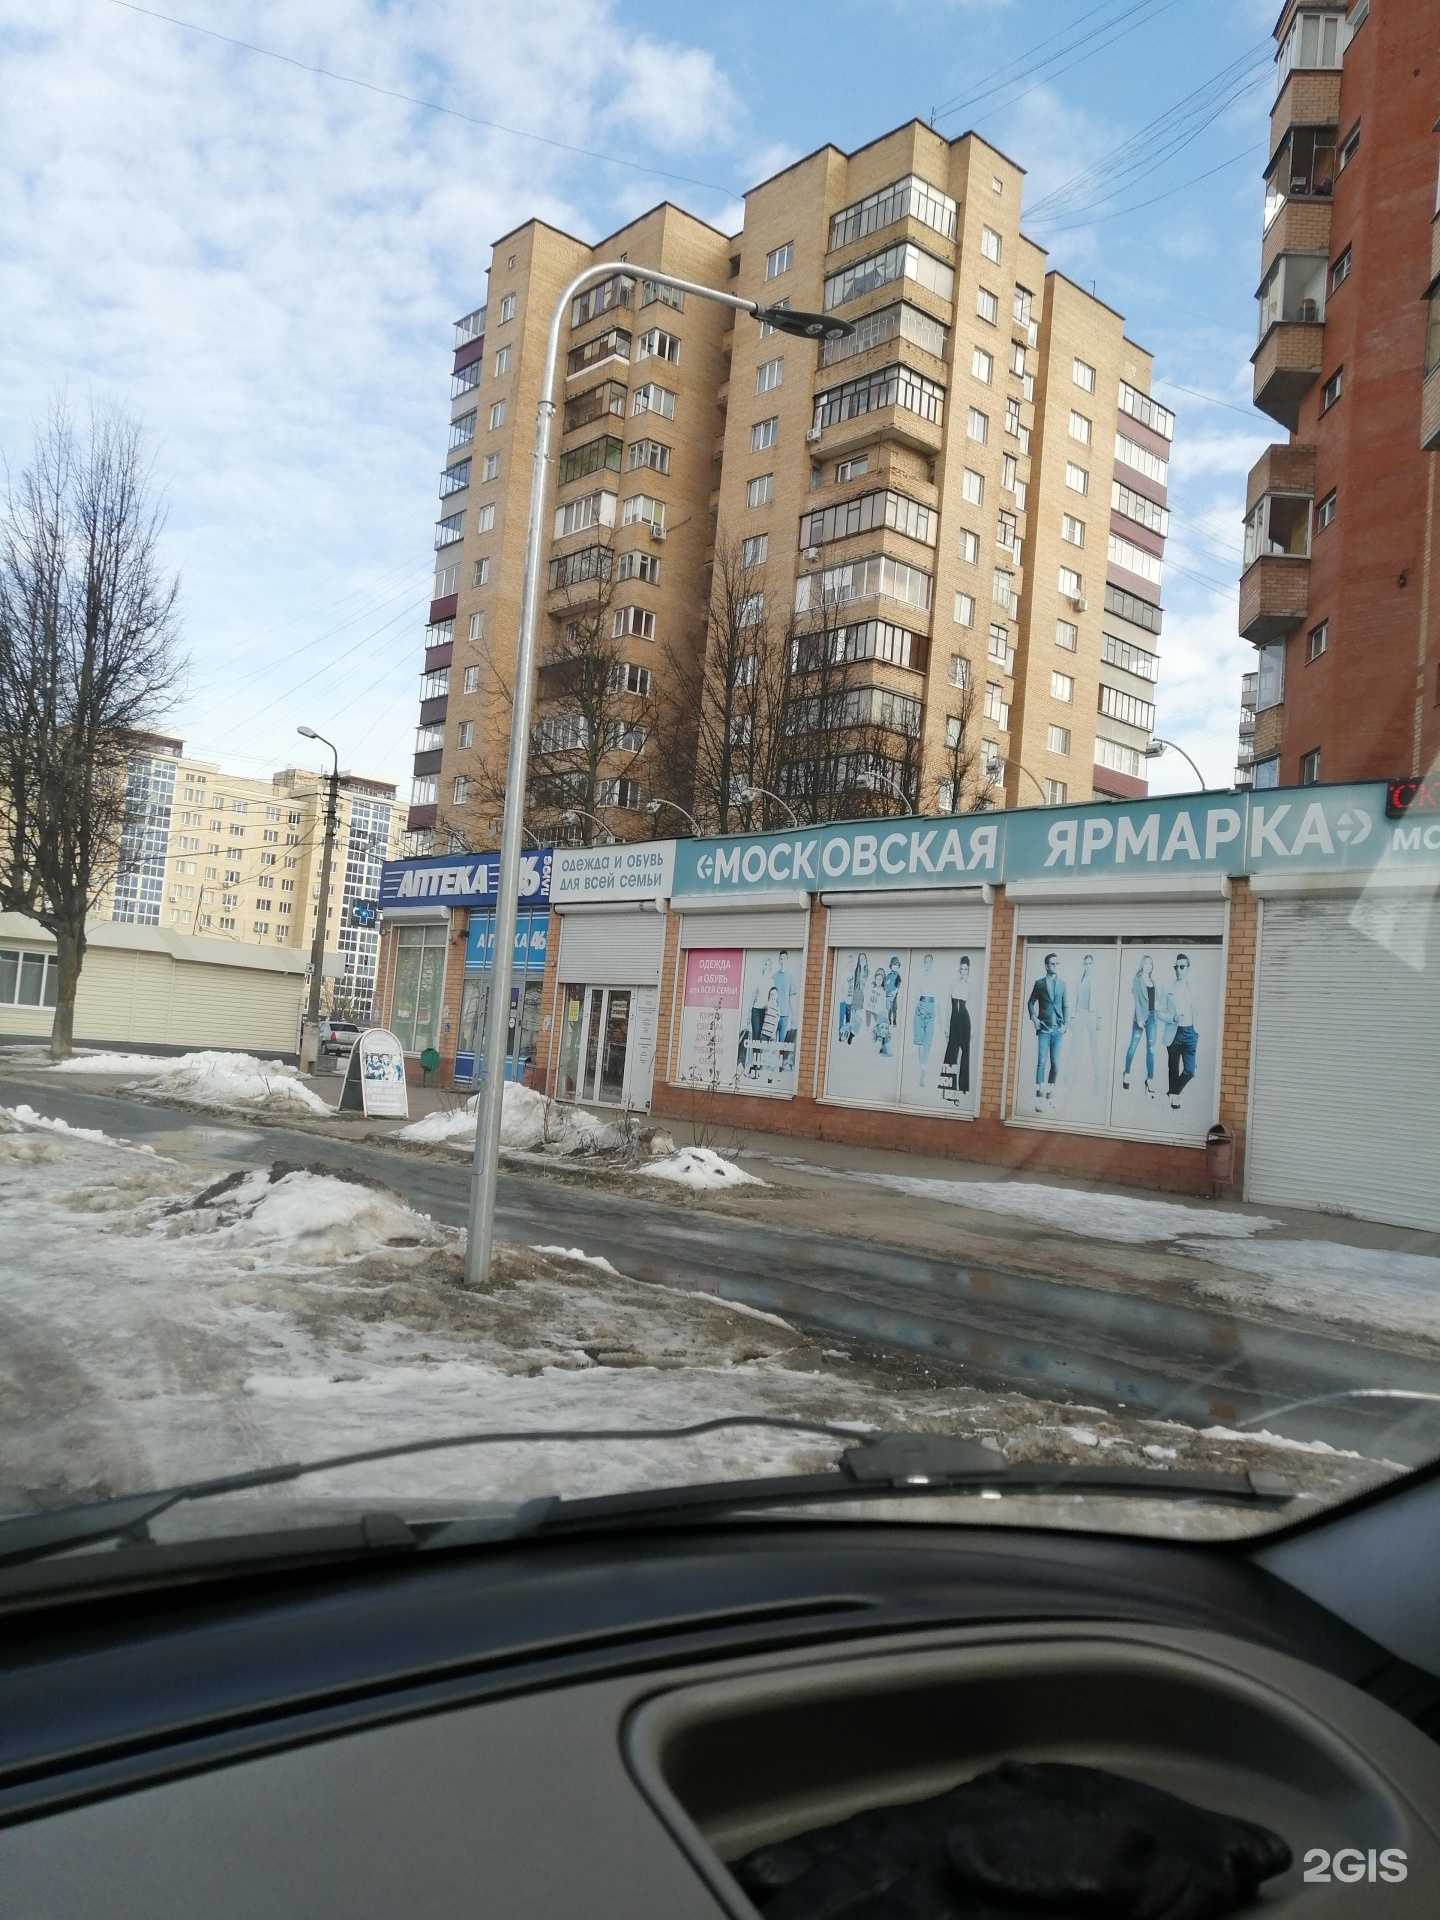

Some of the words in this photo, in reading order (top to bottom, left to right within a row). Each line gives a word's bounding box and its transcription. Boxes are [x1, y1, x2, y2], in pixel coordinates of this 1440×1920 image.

[714, 825, 998, 884] МОСКОВСКАЯ
[1044, 803, 1336, 866] ЯРМАРКА
[397, 864, 488, 898] АПТЕКА
[476, 933, 527, 948] АПКА
[699, 959, 731, 970] ОДЕЖДА
